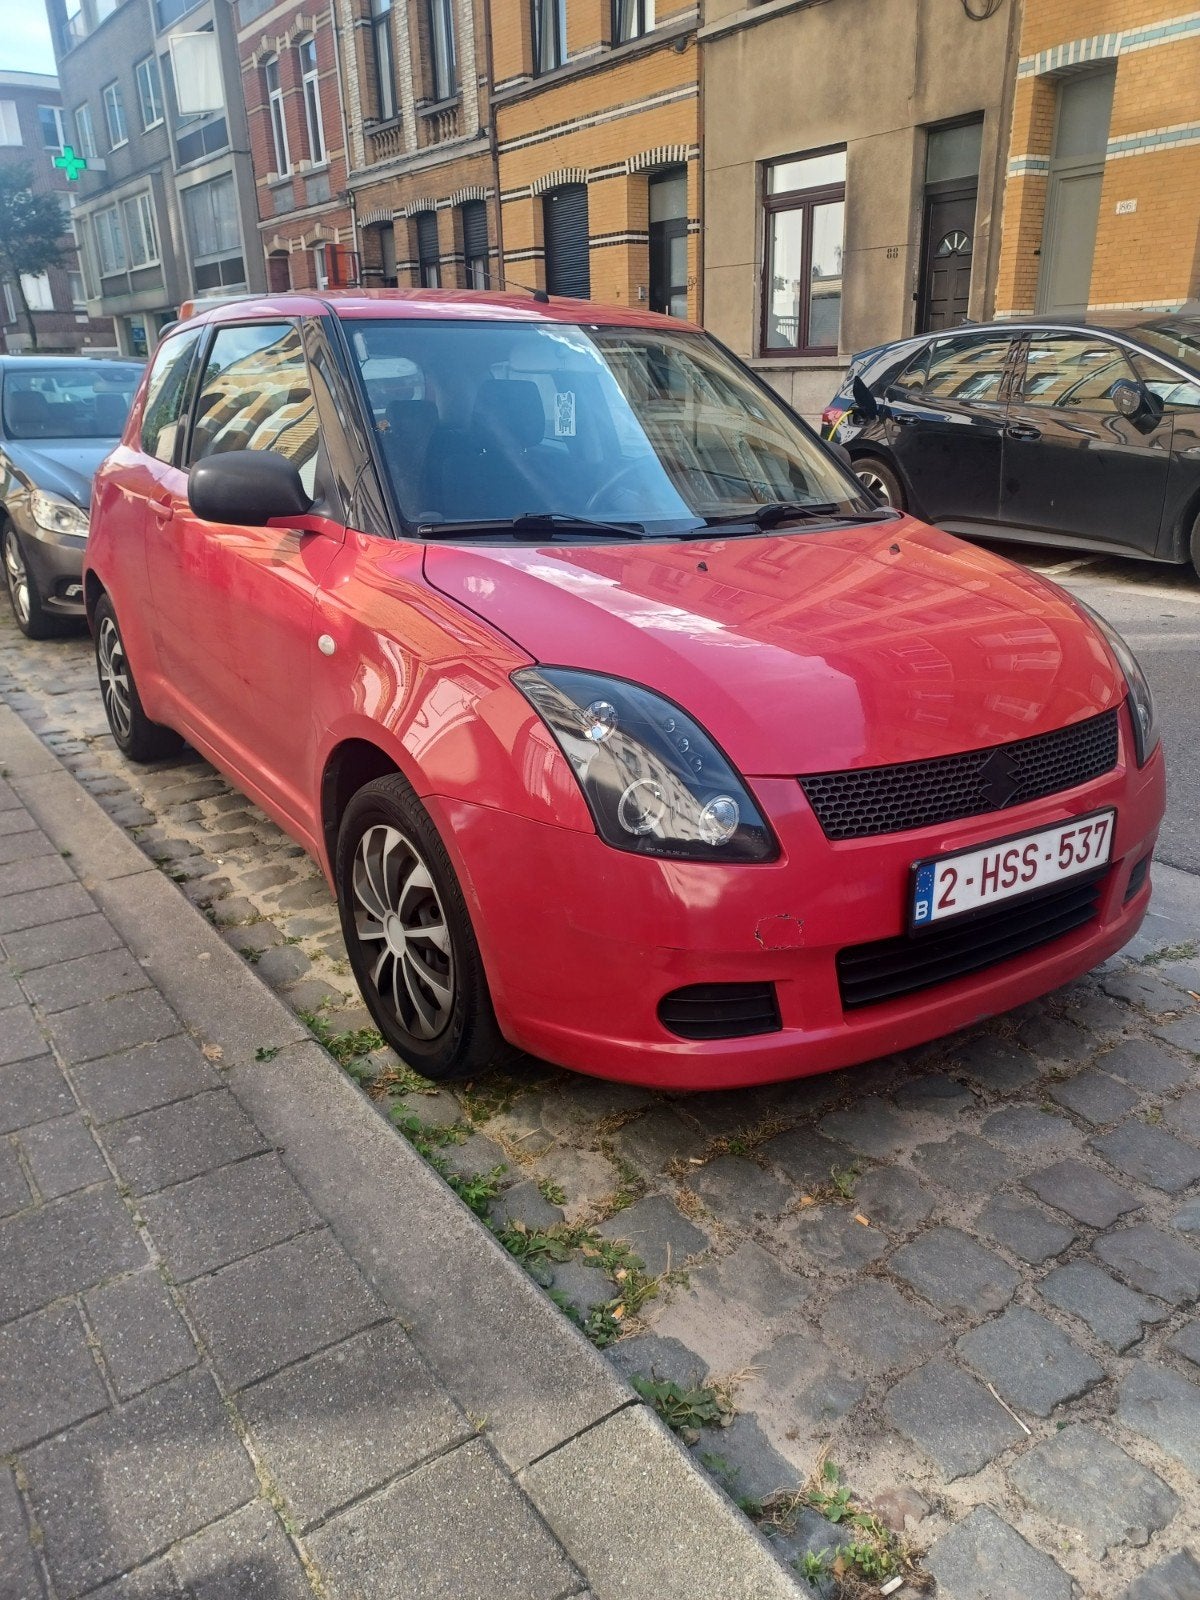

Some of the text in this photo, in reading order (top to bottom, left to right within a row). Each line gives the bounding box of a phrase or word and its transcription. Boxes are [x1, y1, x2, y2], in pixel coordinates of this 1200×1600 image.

[1120, 201, 1132, 210] 86
[886, 247, 899, 259] 88
[937, 820, 1109, 910] 2-HSS-537
[915, 900, 929, 920] B
